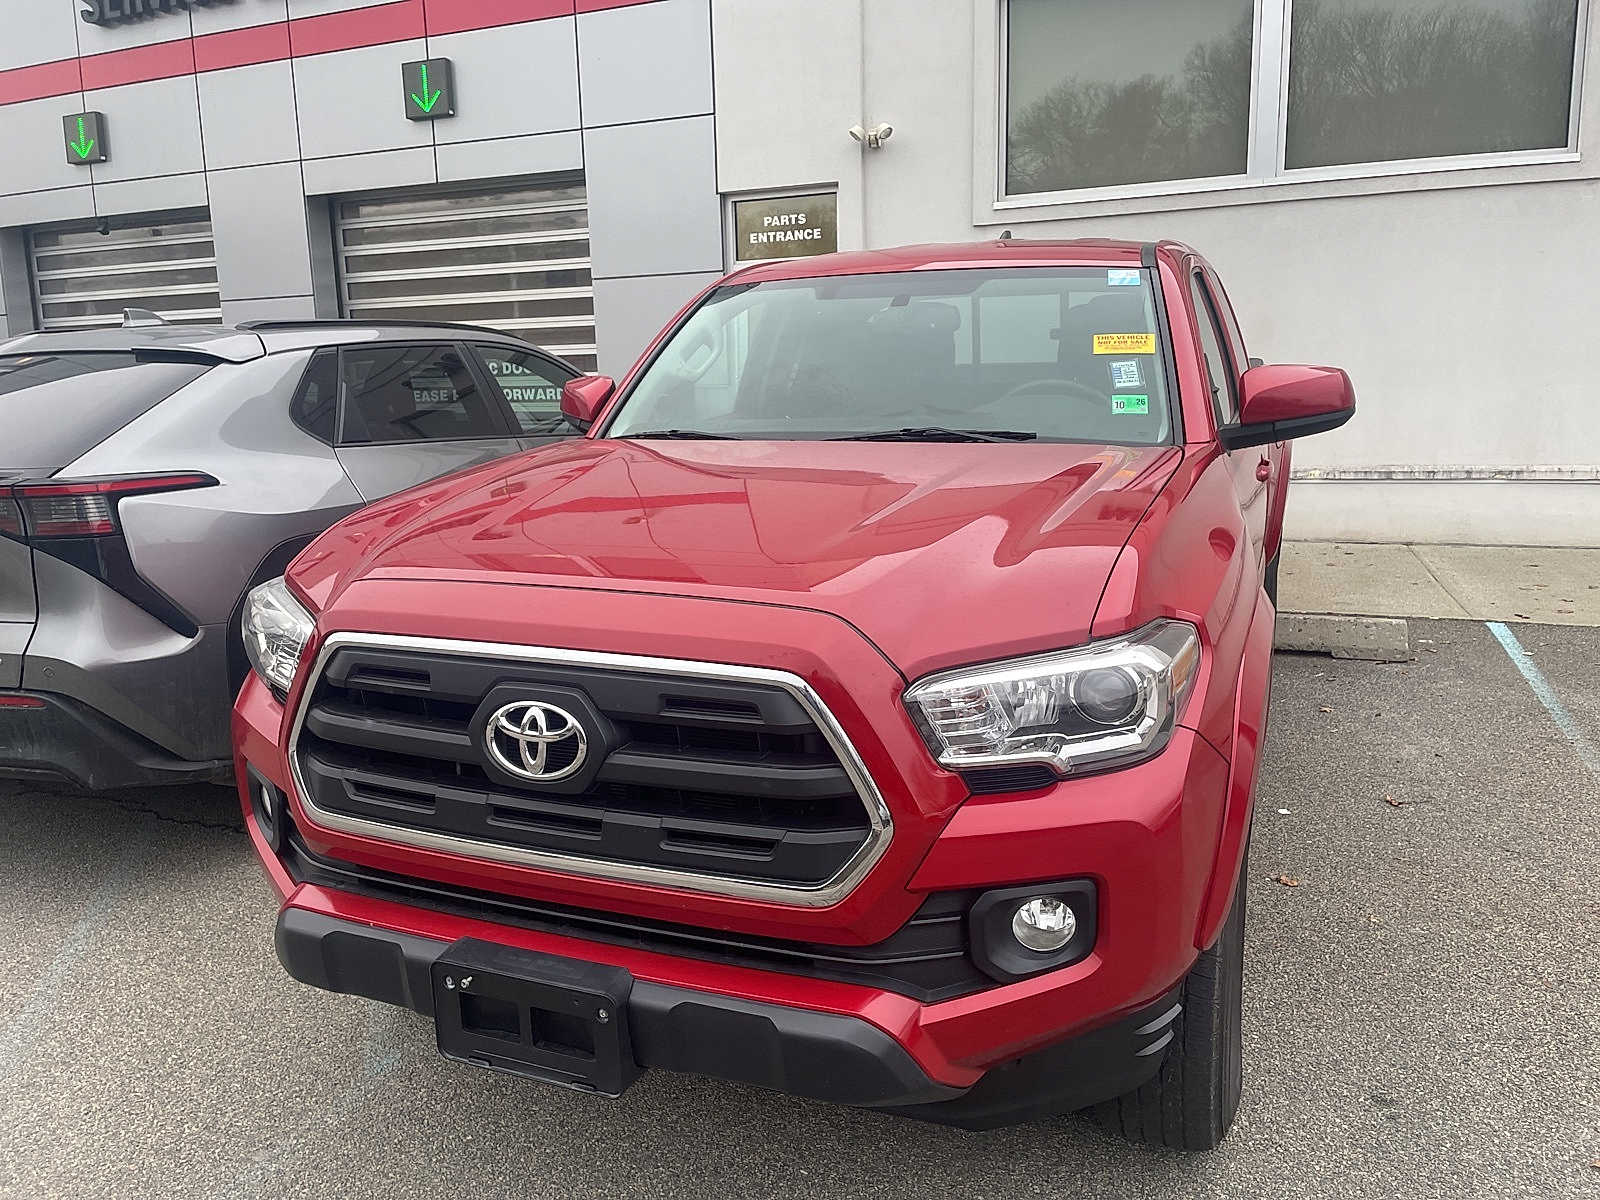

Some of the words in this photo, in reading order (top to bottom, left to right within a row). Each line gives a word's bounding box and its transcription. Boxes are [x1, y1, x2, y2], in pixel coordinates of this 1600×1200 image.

[763, 213, 807, 227] PARTS
[749, 228, 822, 244] ENTRANCE
[488, 362, 498, 375] C
[413, 390, 449, 402] EASE
[502, 388, 564, 401] ORWARD
[1114, 401, 1125, 409] 10
[1135, 398, 1146, 406] 26
